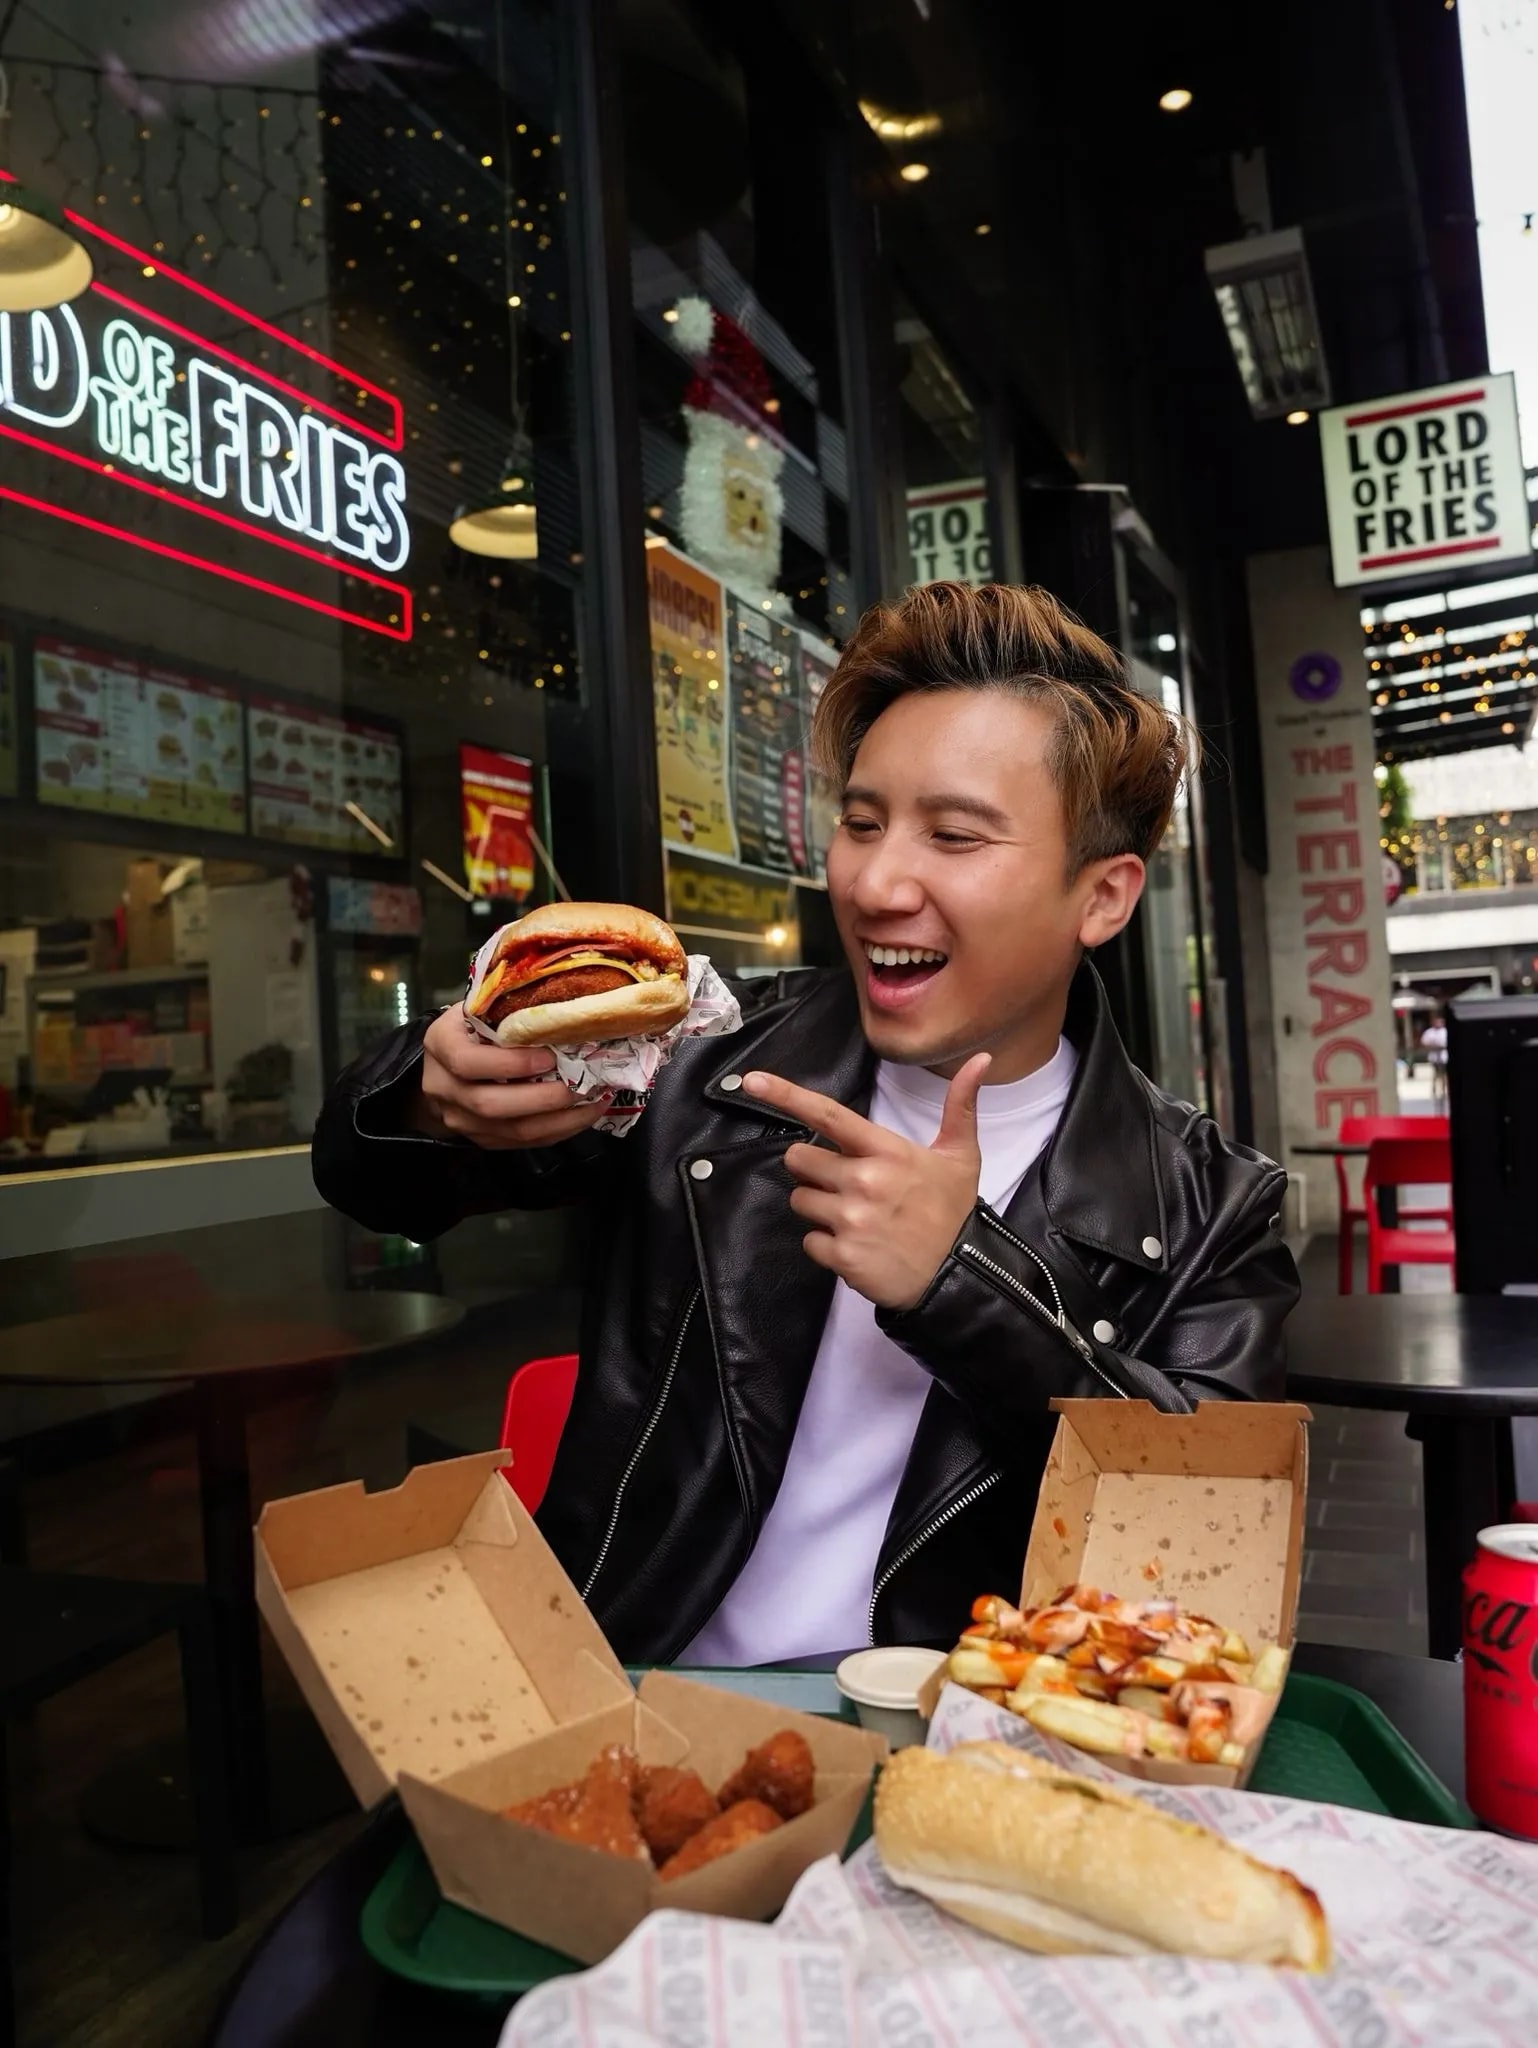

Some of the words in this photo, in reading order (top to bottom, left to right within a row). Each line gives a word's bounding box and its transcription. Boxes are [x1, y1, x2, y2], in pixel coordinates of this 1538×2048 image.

[103, 319, 175, 401] OF
[90, 376, 191, 482] THE
[188, 358, 410, 571] FRIES
[1347, 410, 1488, 473] LORD
[1353, 472, 1400, 508] OF
[1417, 455, 1492, 496] THE
[1356, 492, 1497, 553] FRIES
[1291, 743, 1354, 776] THE
[1294, 781, 1379, 1129] TERRACE
